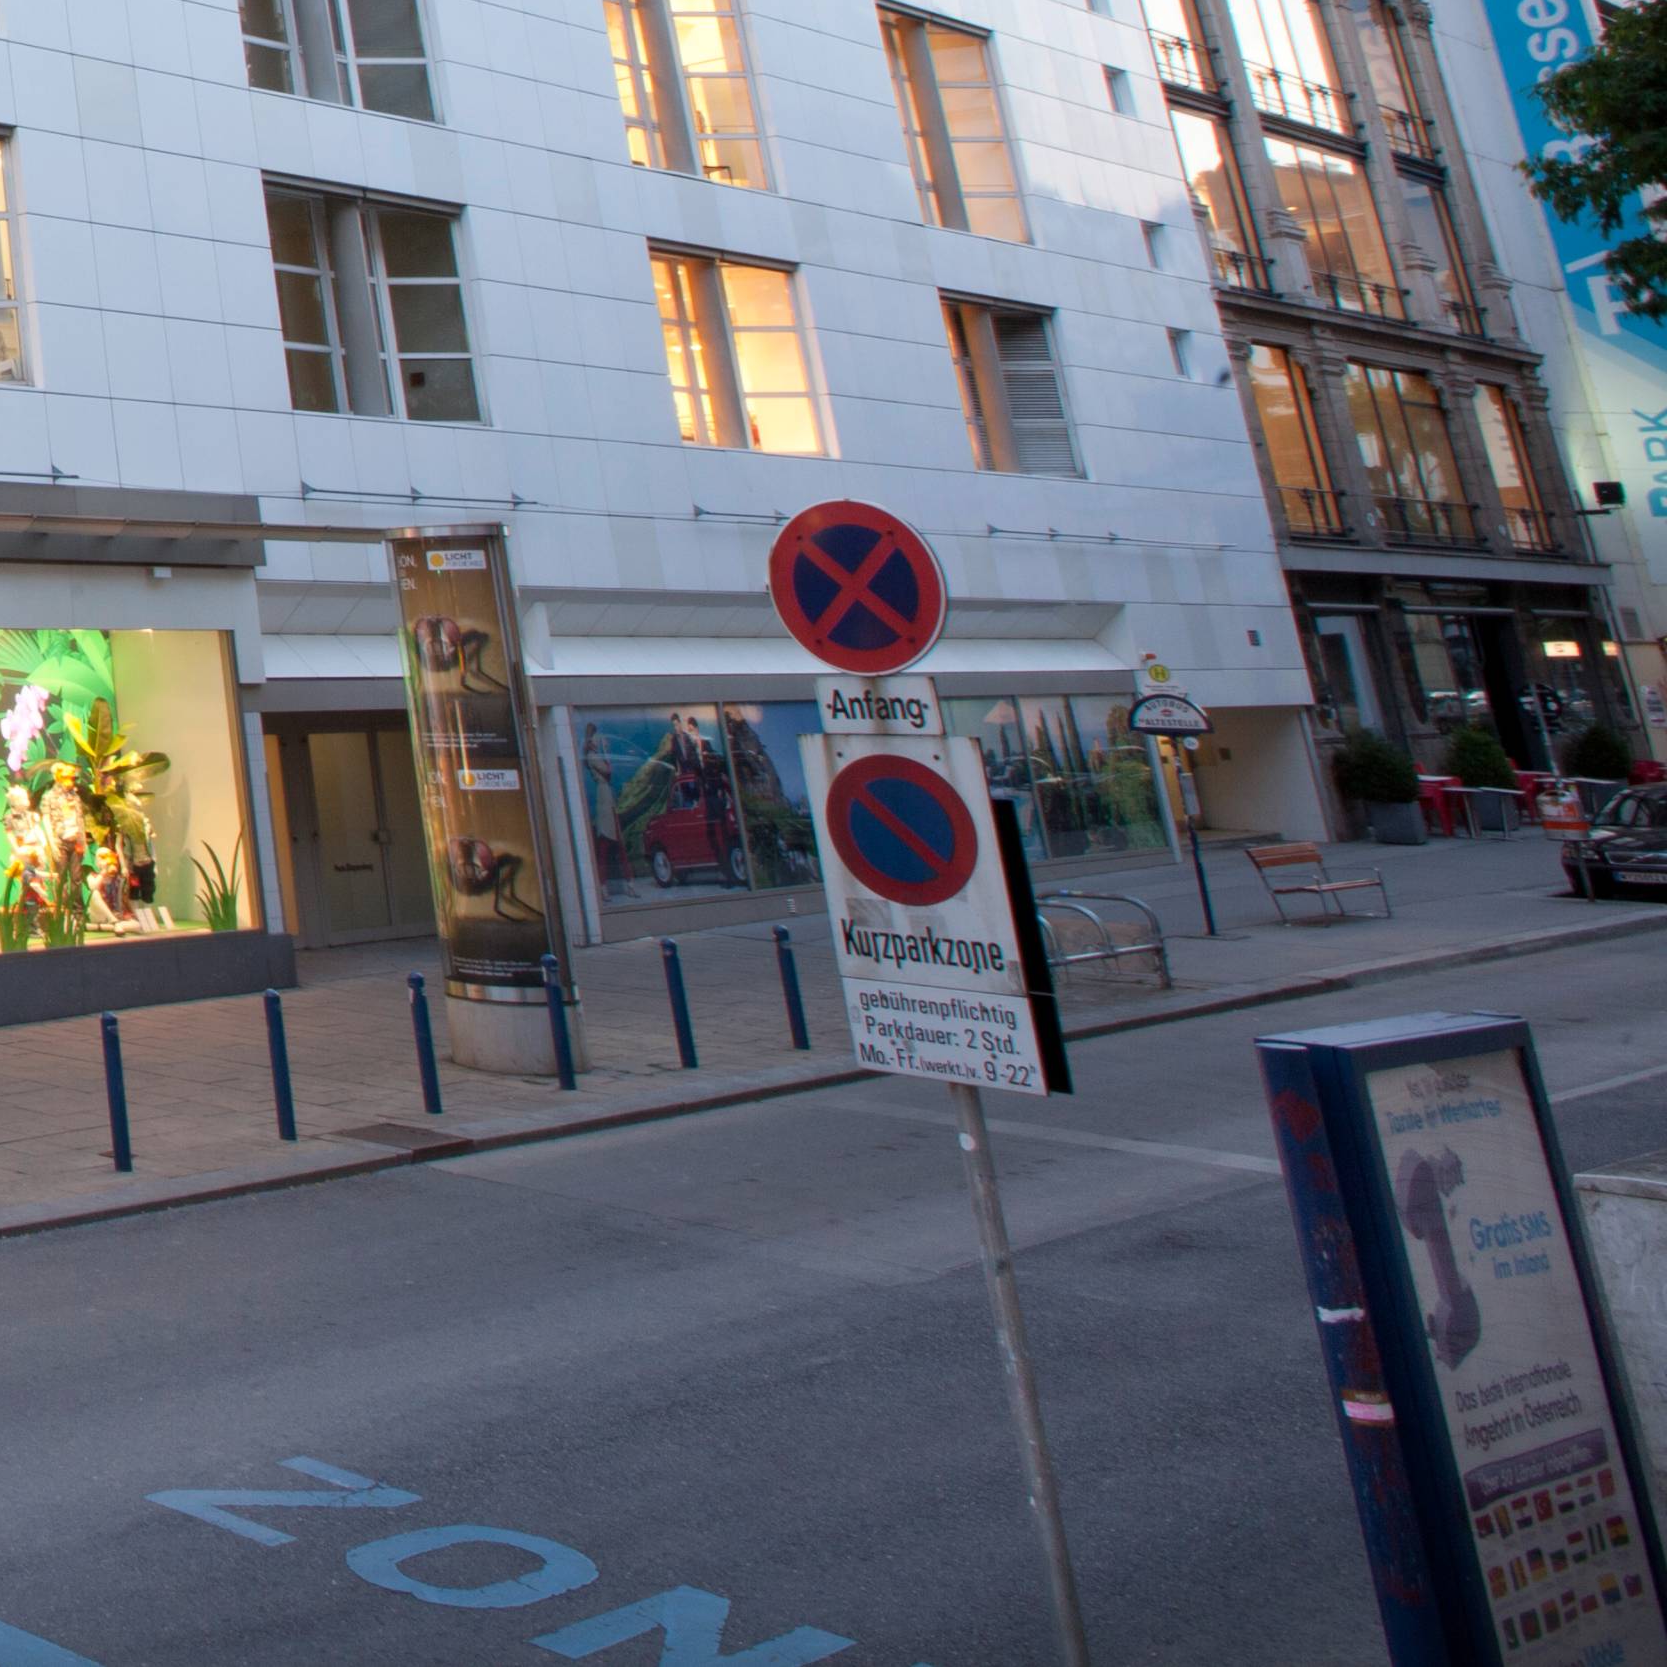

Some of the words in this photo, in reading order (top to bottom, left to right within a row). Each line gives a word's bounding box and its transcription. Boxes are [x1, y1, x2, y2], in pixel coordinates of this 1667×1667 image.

[444, 552, 473, 560] LICHT
[831, 689, 925, 728] Anfang
[477, 771, 505, 781] LICHT
[841, 918, 1005, 975] Kurzparkzone
[860, 990, 1017, 1031] gebührenpflichtig
[864, 1015, 960, 1047] Parkdauer:
[964, 1029, 978, 1049] 2
[982, 1031, 1021, 1055] Std.
[1470, 1214, 1522, 1251] Gratis
[1520, 1211, 1552, 1241] SMS
[1455, 1389, 1479, 1413] Das
[1522, 1387, 1582, 1429] Österreich
